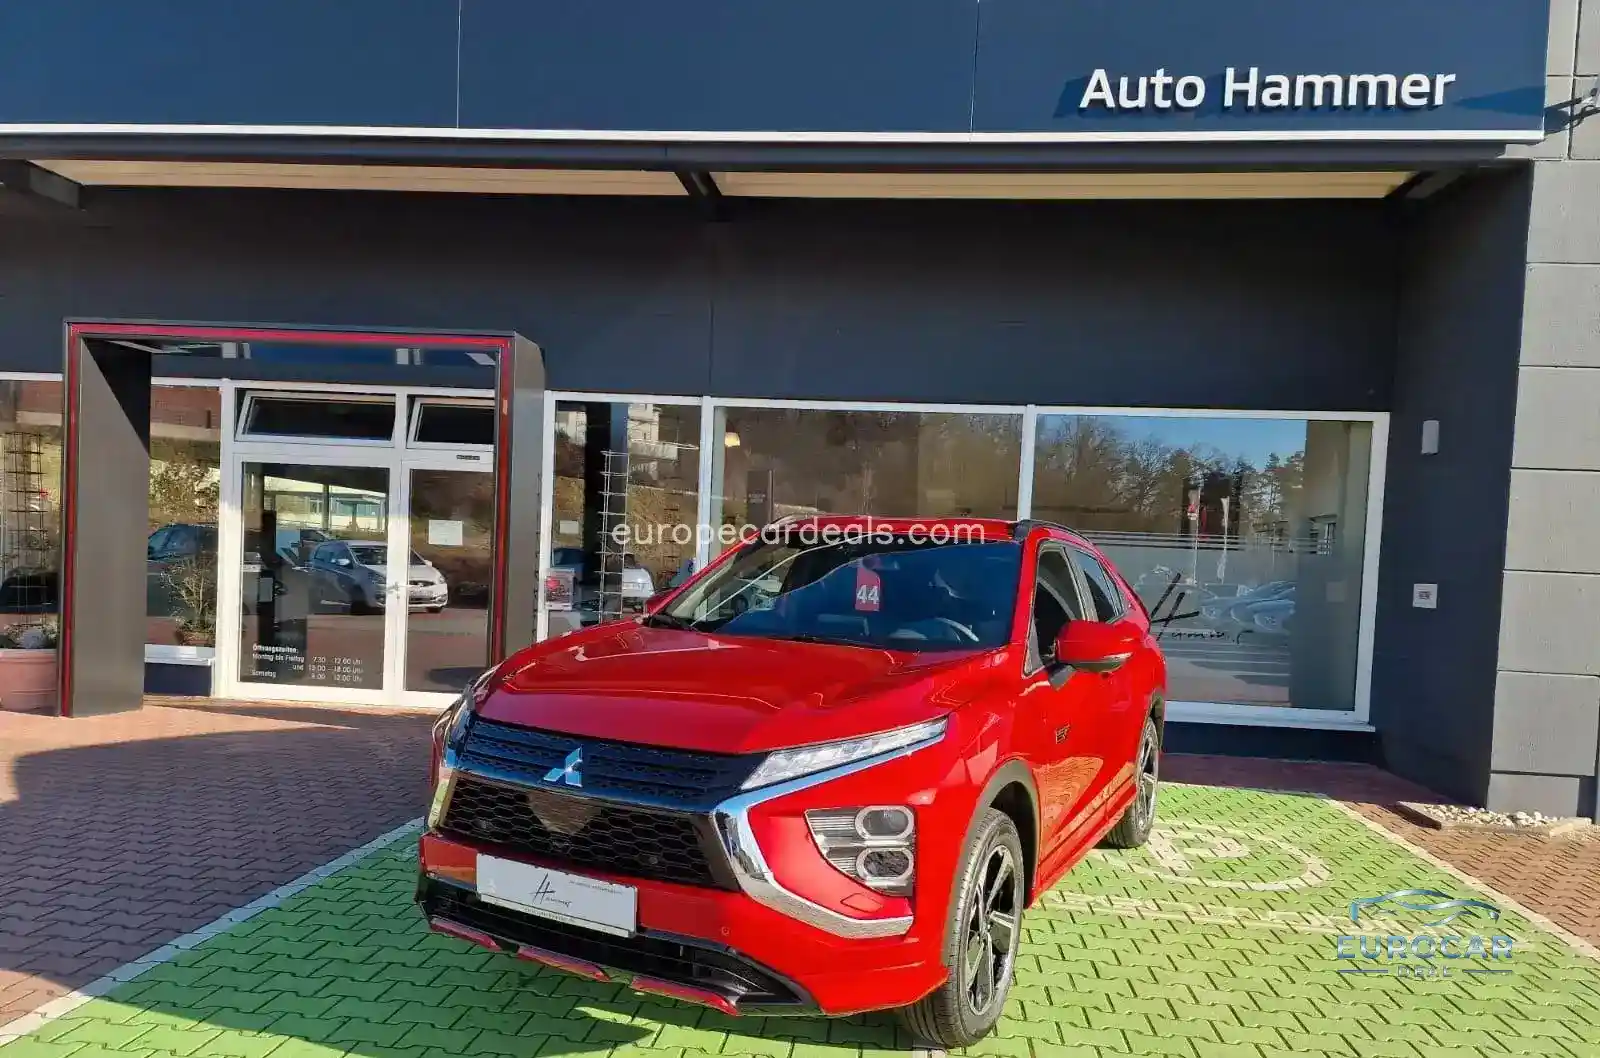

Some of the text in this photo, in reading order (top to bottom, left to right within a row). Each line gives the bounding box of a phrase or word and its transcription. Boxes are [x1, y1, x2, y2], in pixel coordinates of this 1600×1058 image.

[1079, 66, 1457, 110] Auto Hammer
[857, 584, 880, 605] 44
